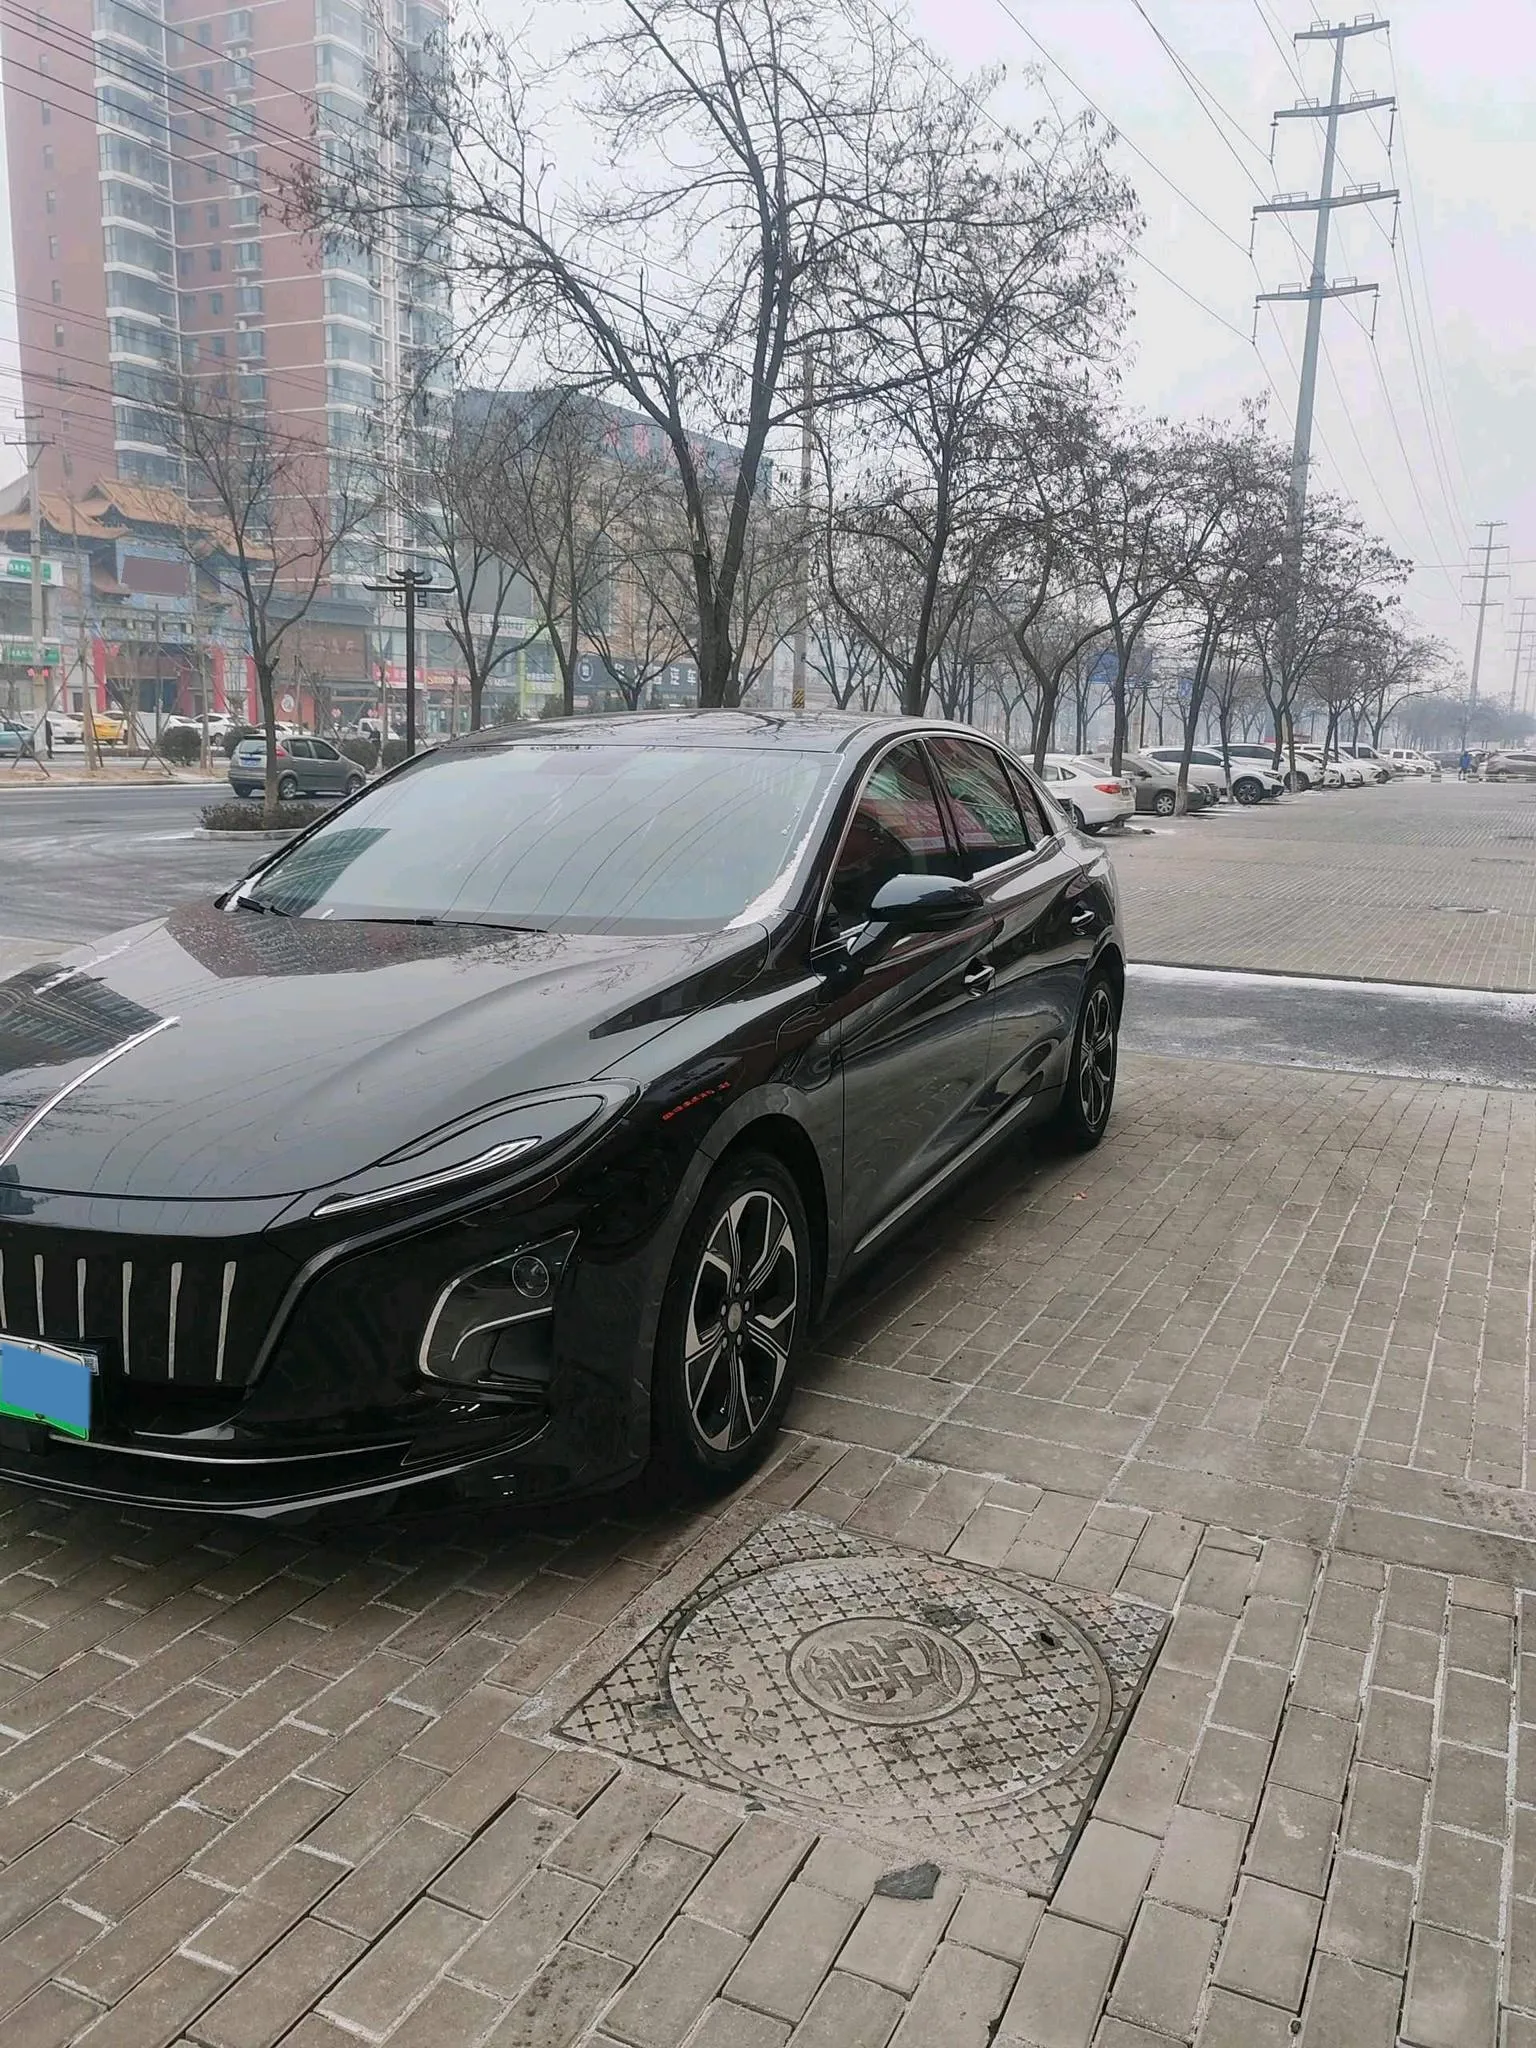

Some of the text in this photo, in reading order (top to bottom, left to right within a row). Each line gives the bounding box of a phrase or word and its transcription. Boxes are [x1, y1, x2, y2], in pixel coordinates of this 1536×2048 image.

[966, 1634, 1014, 1666] 污水
[695, 1645, 780, 1749] 孝义老城
